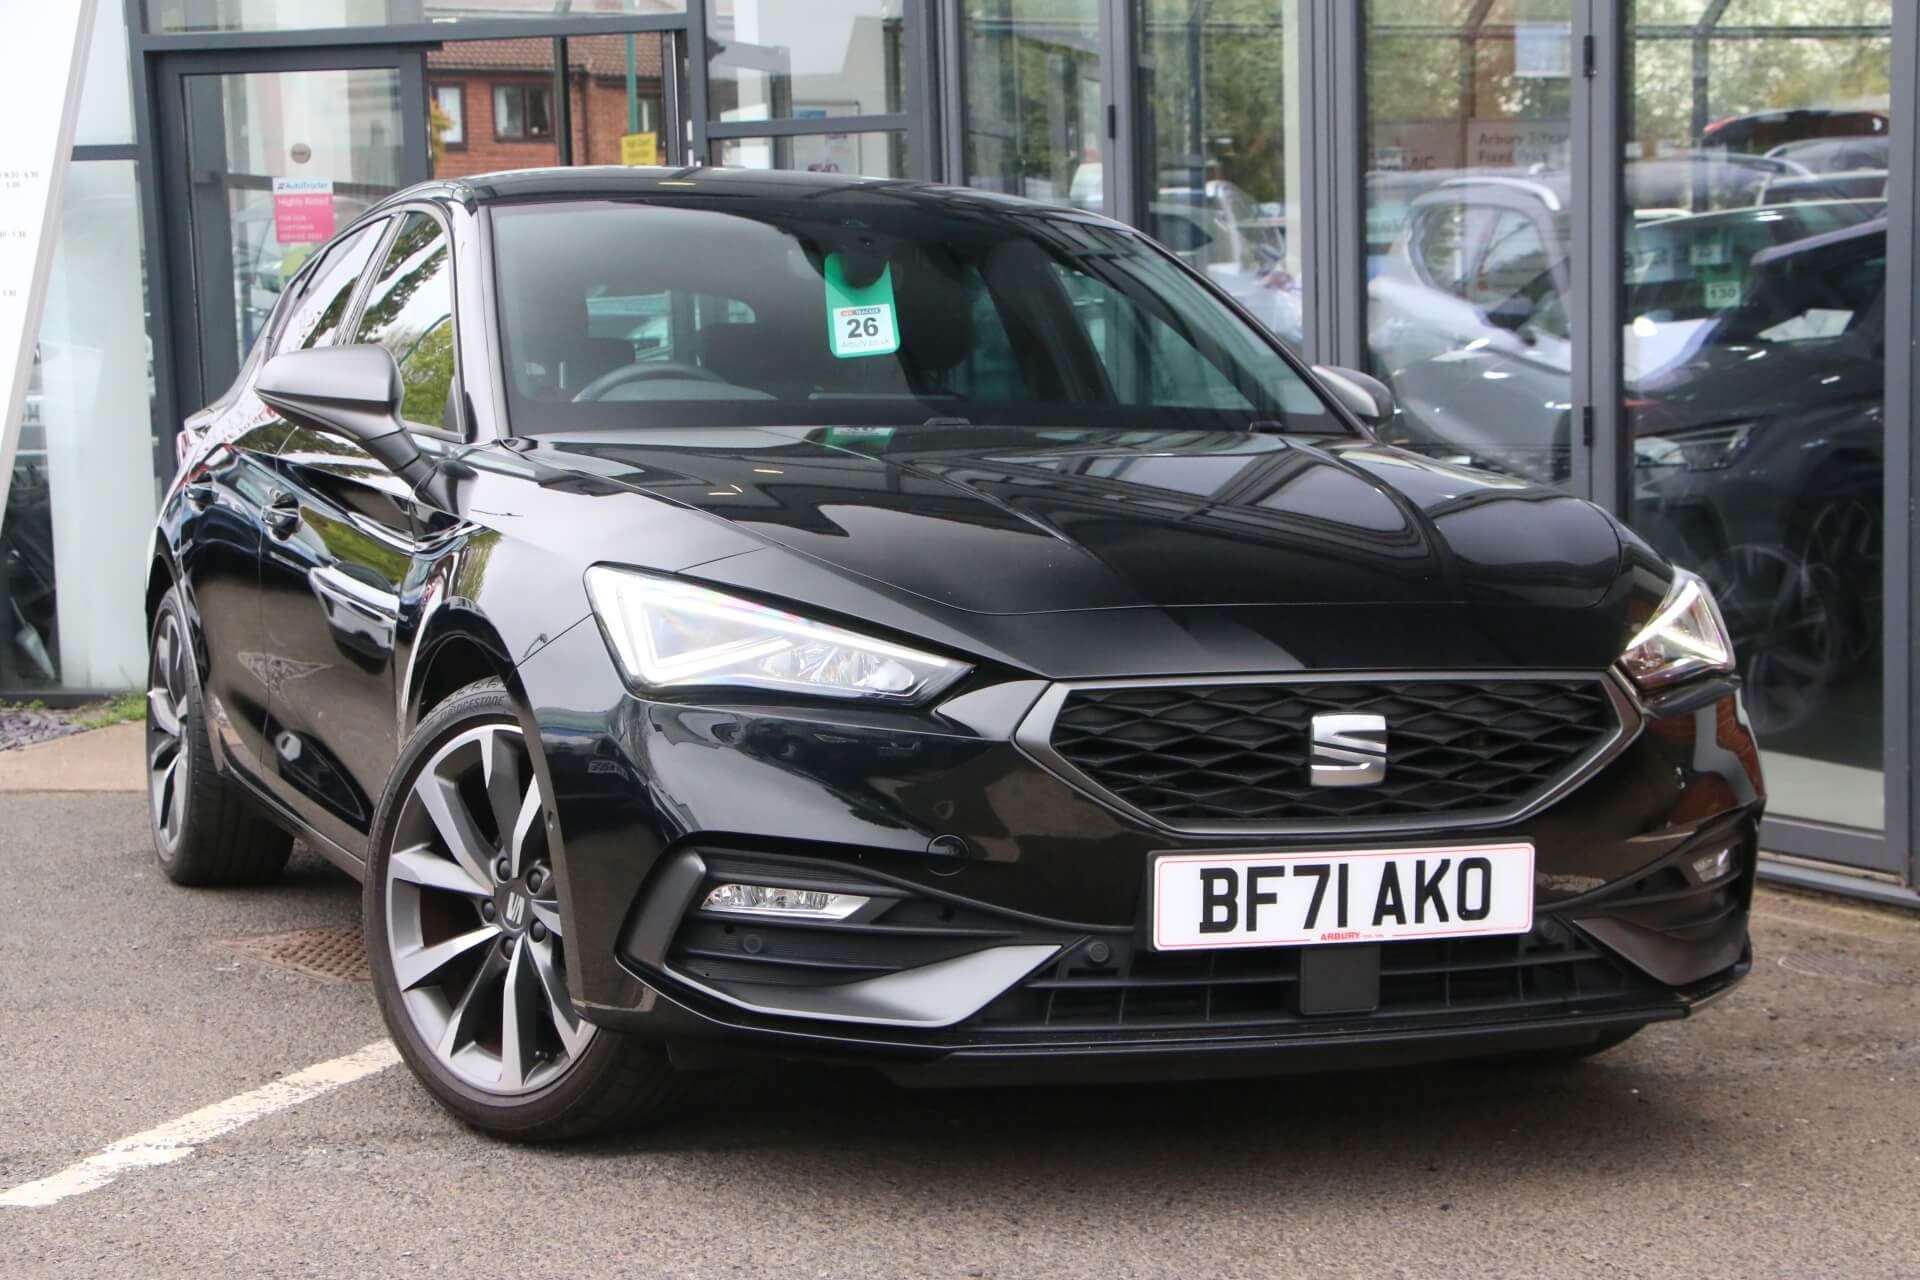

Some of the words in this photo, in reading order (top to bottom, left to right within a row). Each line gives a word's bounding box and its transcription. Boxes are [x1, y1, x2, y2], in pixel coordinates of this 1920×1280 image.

[846, 317, 879, 338] 26
[1199, 862, 1349, 934] BF71
[1372, 857, 1492, 927] AKO
[1320, 931, 1361, 941] ARBURY
